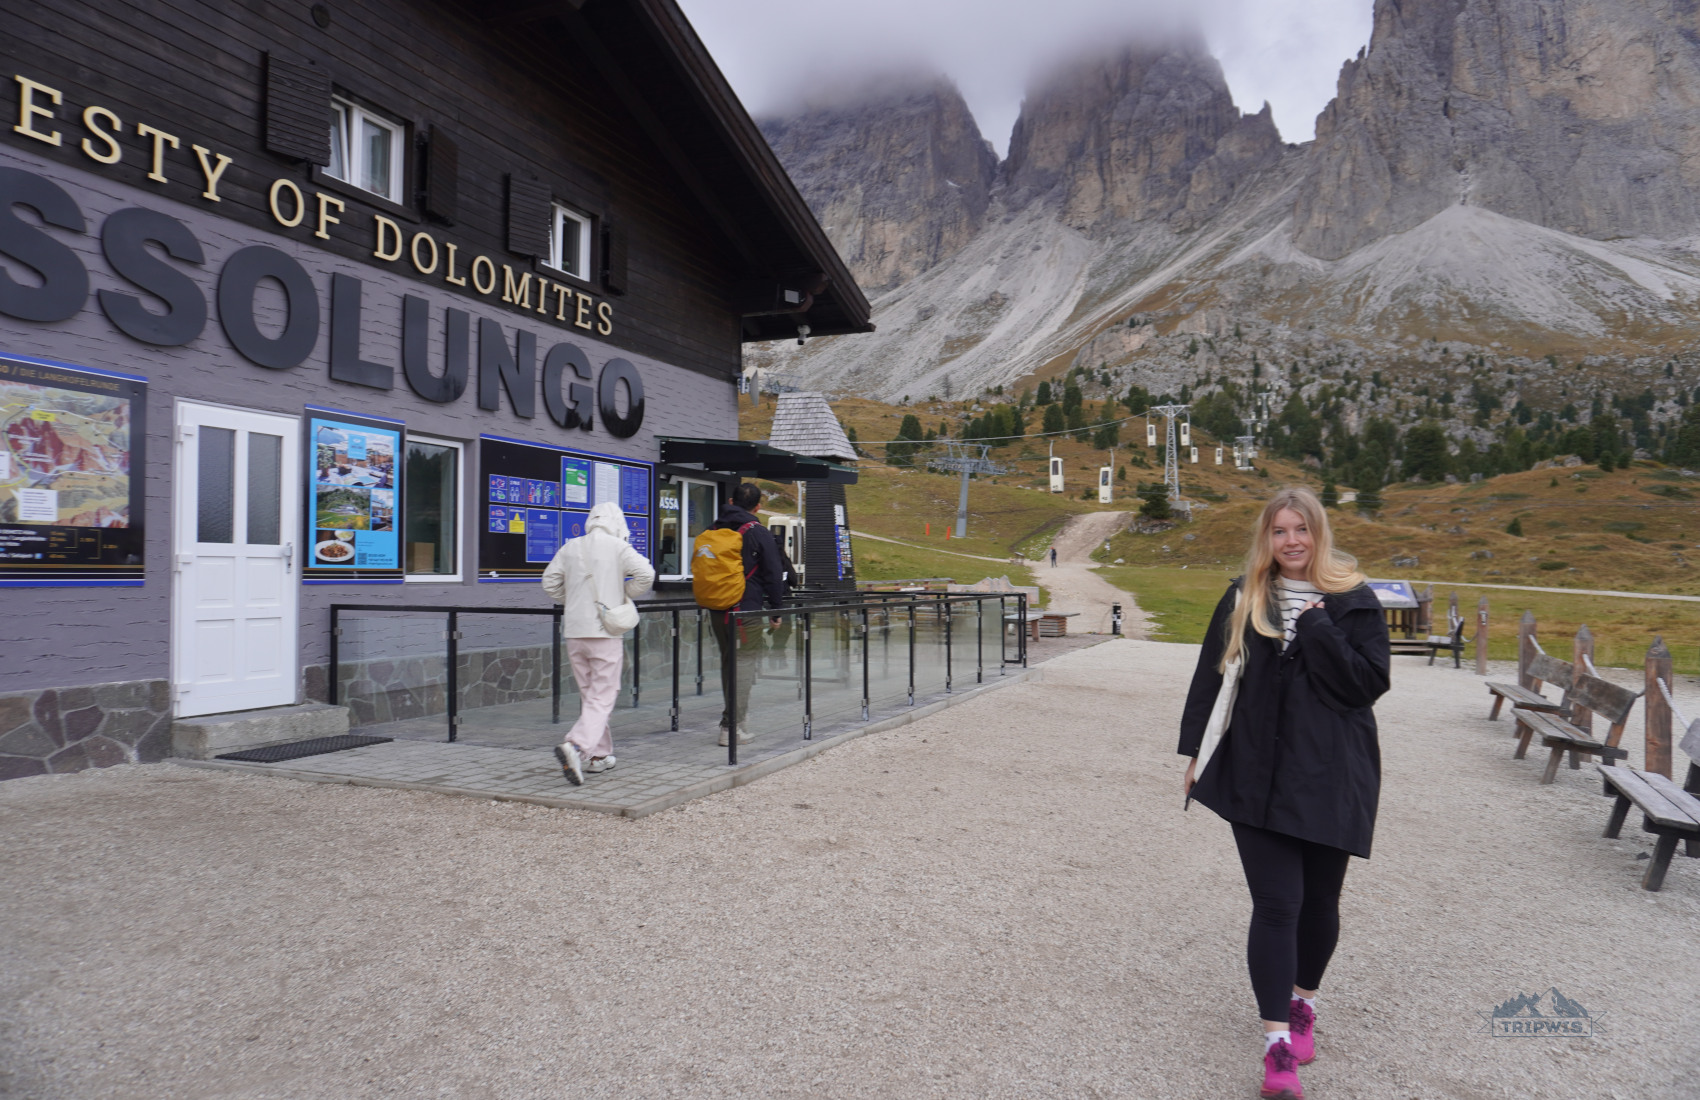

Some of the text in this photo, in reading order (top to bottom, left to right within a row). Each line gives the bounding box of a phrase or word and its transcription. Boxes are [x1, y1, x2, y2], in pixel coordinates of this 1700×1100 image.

[0, 166, 645, 438] SSOLUNGO
[13, 74, 614, 336] ESTY OF DOLOMITES
